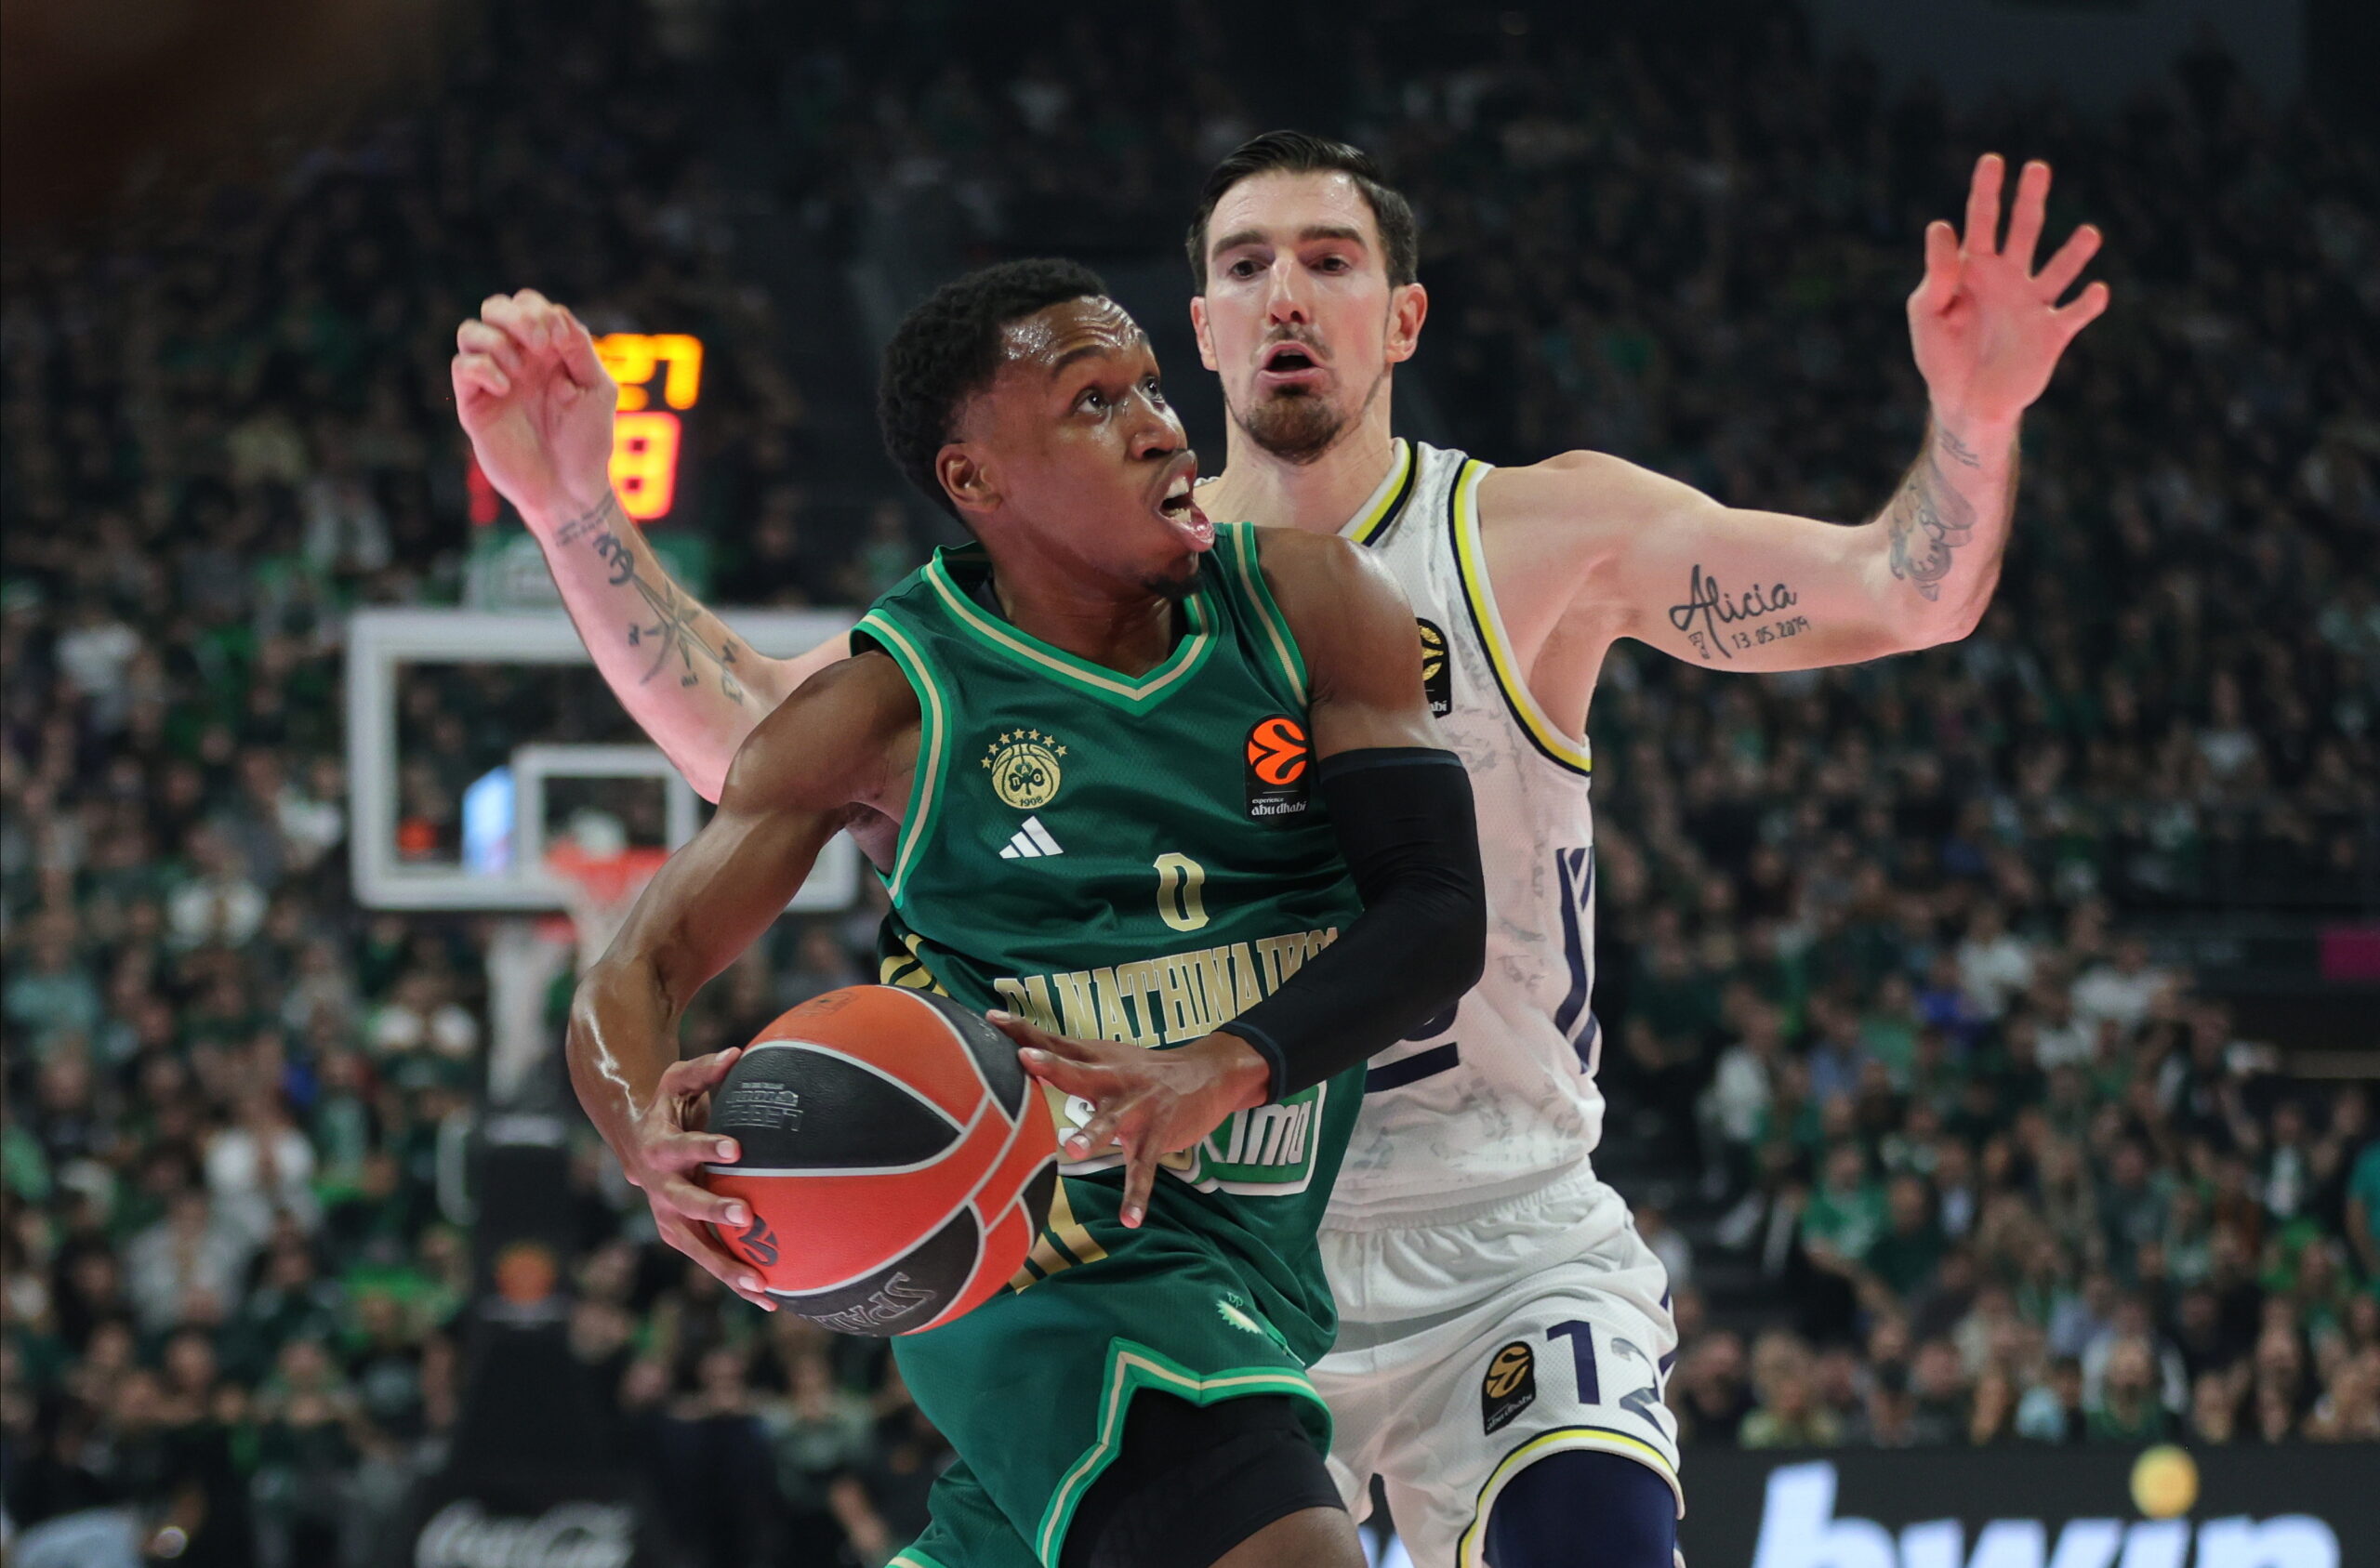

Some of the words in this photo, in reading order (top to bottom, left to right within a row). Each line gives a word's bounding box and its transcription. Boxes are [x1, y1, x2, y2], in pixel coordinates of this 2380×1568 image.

[1669, 564, 1797, 659] Alicia
[1020, 796, 1044, 808] 1908
[1251, 804, 1276, 816] abu
[1276, 800, 1307, 814] dhabi
[1156, 851, 1210, 932] 0
[993, 927, 1338, 1049] PANATHINAIK
